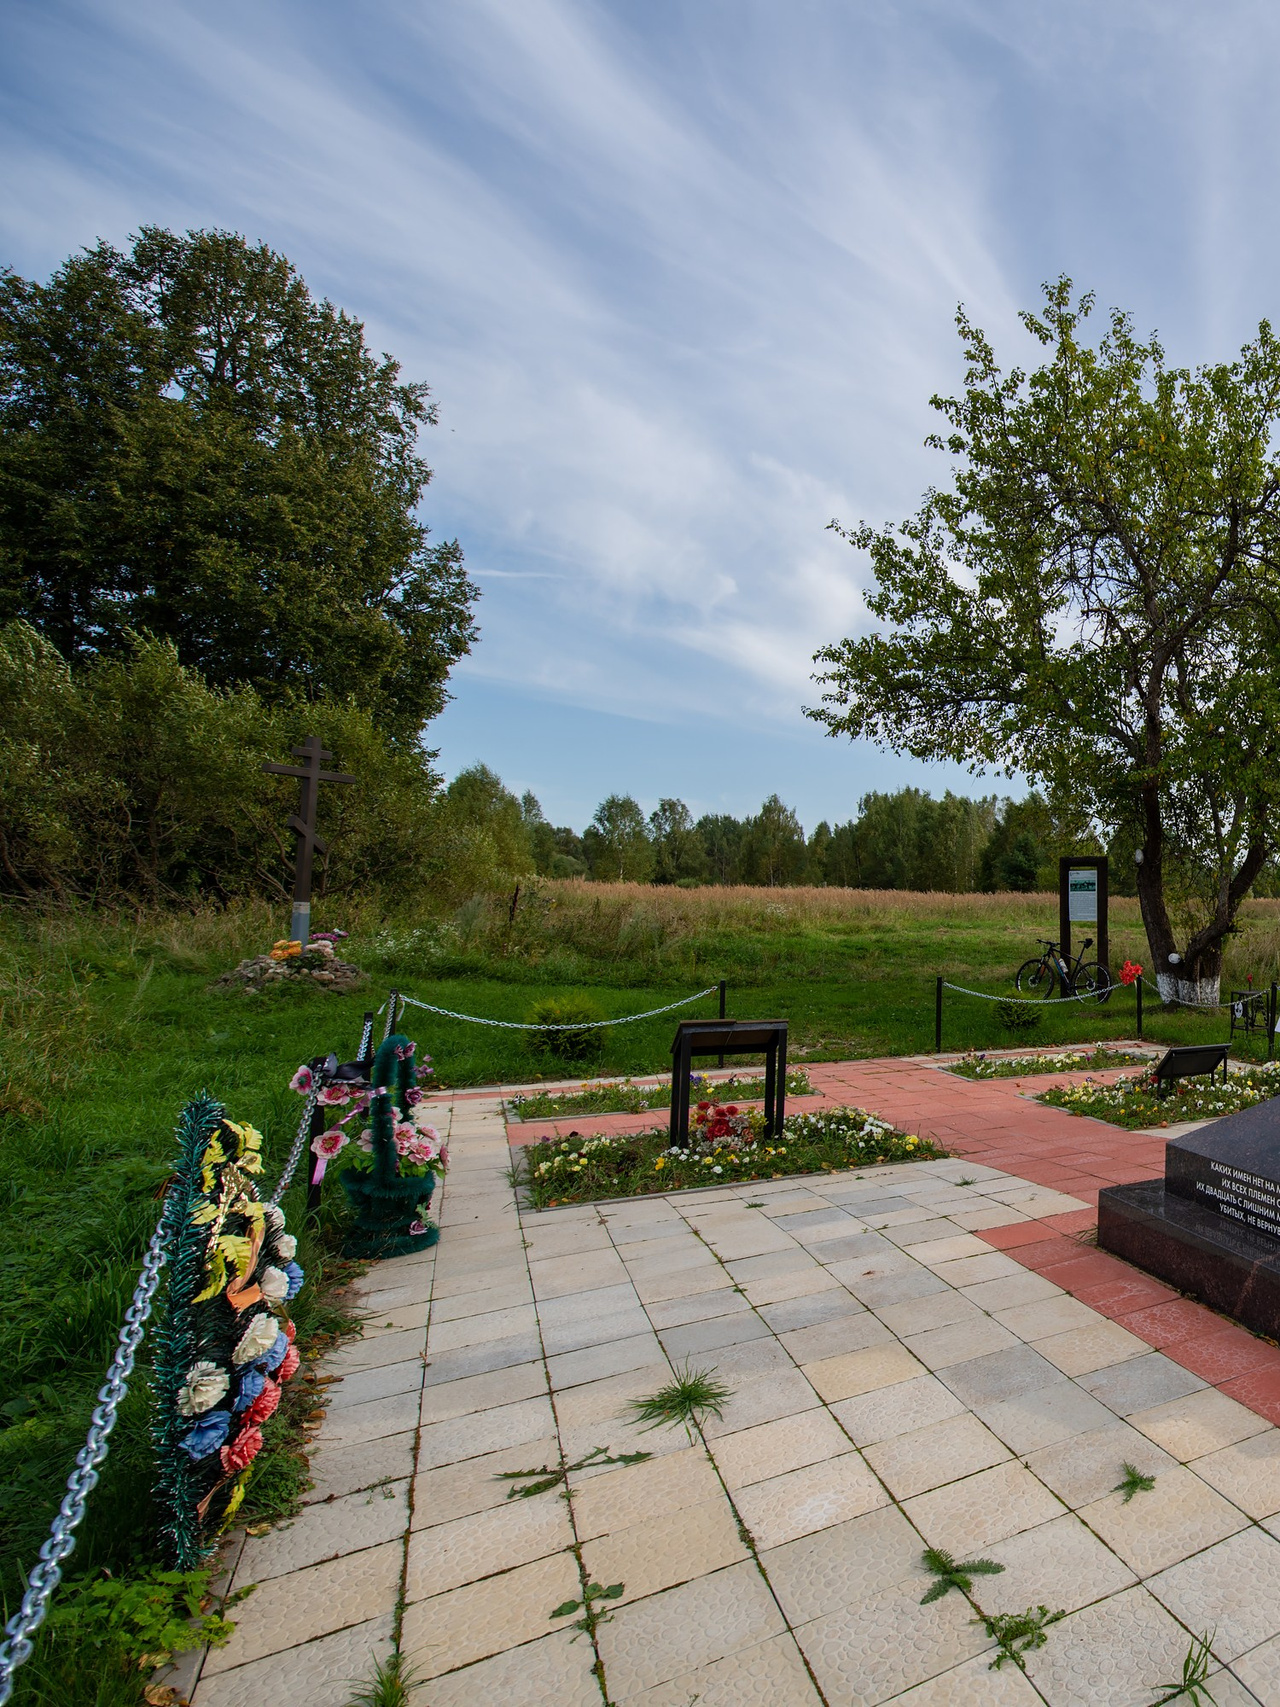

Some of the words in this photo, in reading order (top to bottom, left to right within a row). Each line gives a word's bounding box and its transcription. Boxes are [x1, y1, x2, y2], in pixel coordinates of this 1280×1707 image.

[1210, 1161, 1232, 1177] КАКИХ
[1232, 1168, 1252, 1184] ИМЕН
[1252, 1177, 1265, 1188] НЕТ
[1264, 1180, 1276, 1193] НА
[1196, 1180, 1205, 1192] ИХ
[1205, 1184, 1237, 1205] ДВАДЦАТЬ
[1237, 1197, 1243, 1207] С
[1242, 1199, 1276, 1220] ЛИШНИМ
[1221, 1178, 1231, 1190] ИХ
[1231, 1182, 1248, 1196] ВСЕХ
[1248, 1188, 1276, 1207] ПЛЕМЕН
[1219, 1202, 1246, 1223] УБИТЫХ,
[1247, 1214, 1256, 1226] НЕ
